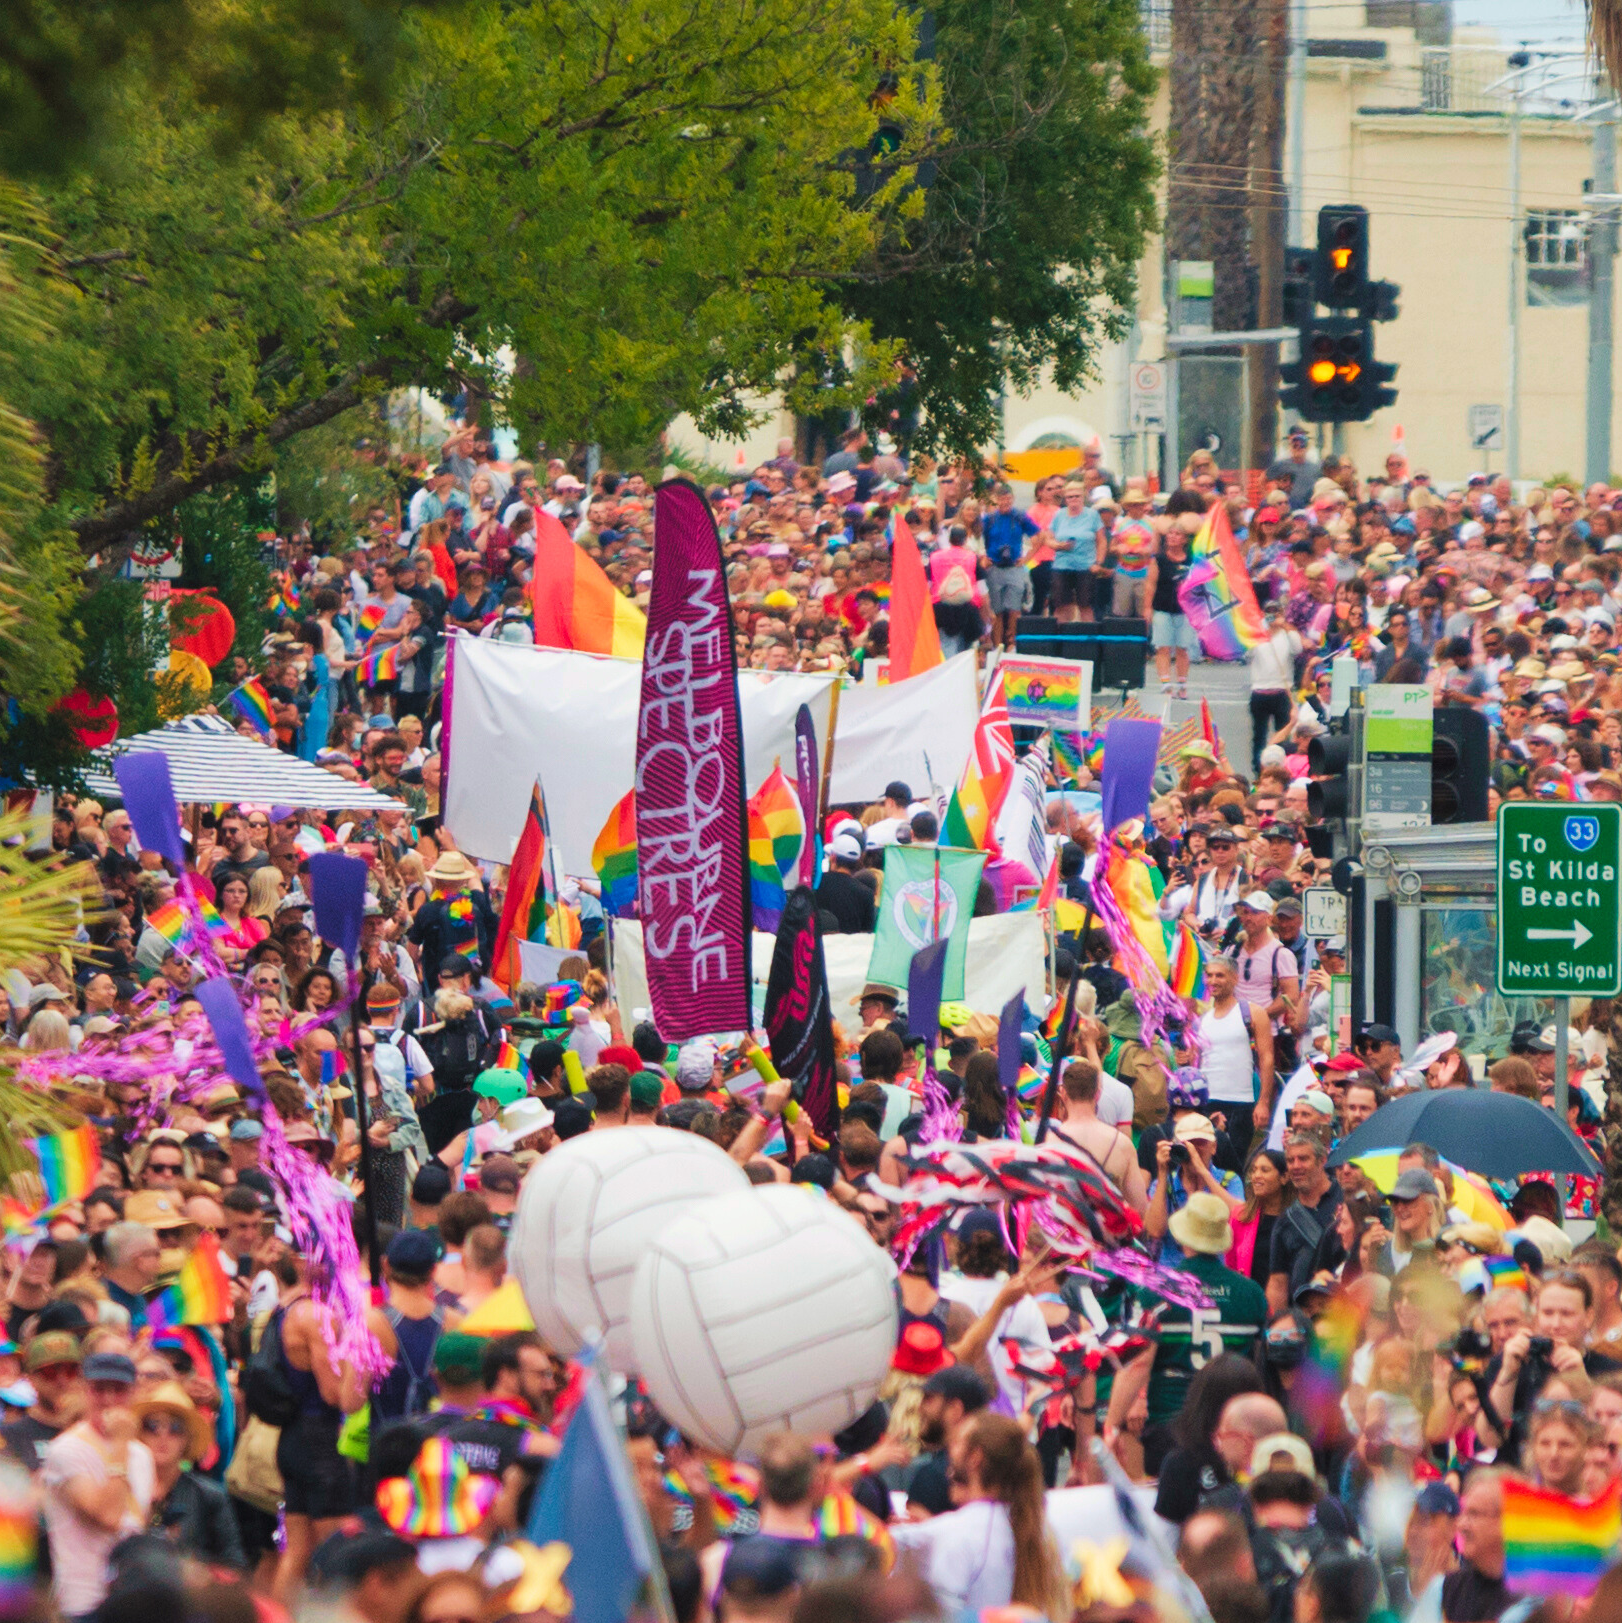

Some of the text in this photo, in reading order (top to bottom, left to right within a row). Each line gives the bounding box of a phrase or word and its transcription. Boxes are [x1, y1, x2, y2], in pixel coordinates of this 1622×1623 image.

[635, 620, 698, 960] SPECTRES
[687, 568, 729, 993] MELBOURNE
[1369, 784, 1382, 794] 16
[1570, 822, 1595, 841] 33
[1518, 833, 1547, 853] To
[1508, 860, 1615, 881] St Kilda
[1521, 886, 1601, 907] Beach
[1508, 960, 1613, 983] Next Signal
[1190, 1309, 1224, 1370] 5
